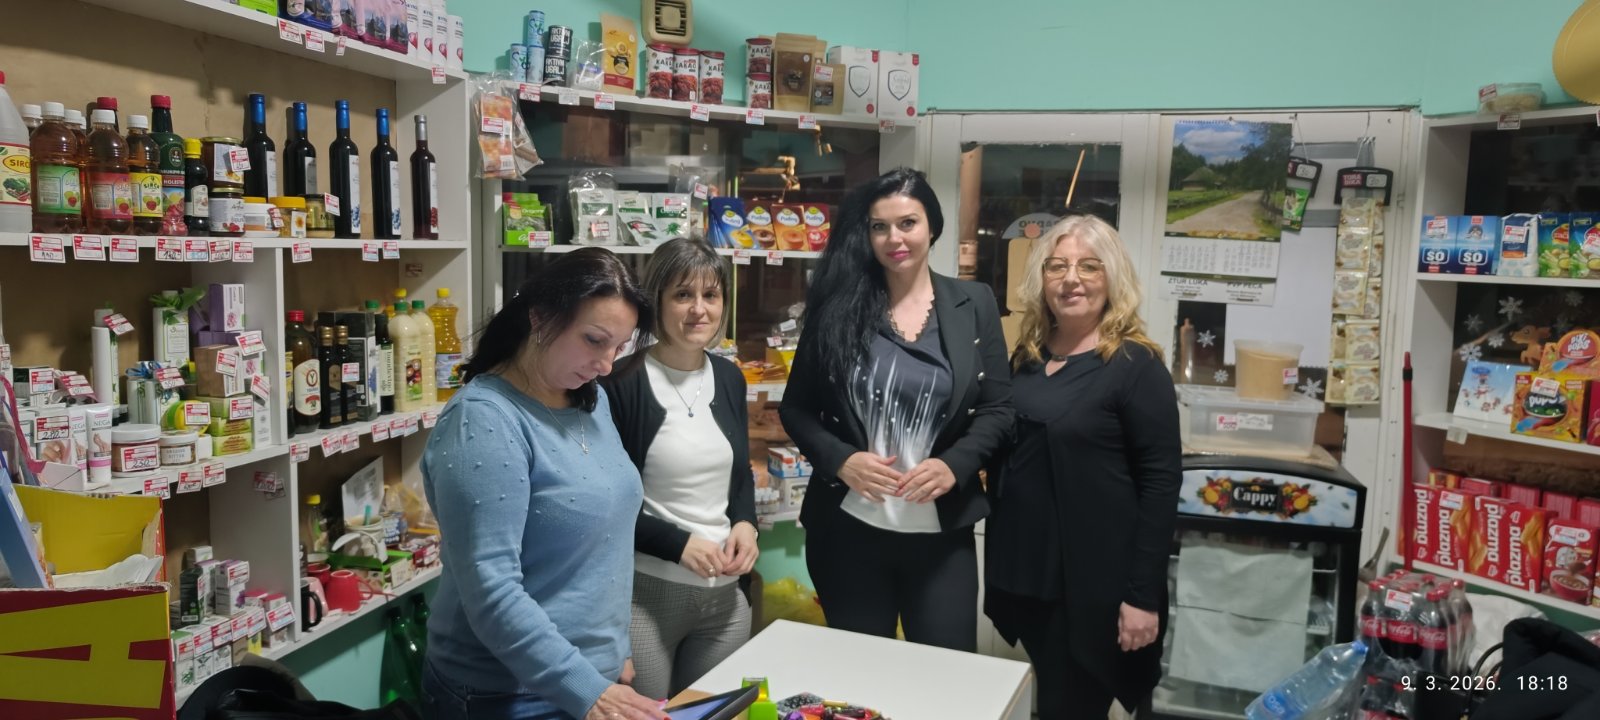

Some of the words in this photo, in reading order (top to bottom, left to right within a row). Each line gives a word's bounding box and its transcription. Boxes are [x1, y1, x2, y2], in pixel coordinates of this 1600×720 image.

[1233, 486, 1277, 507] Cappy
[1413, 489, 1431, 545] plazma
[1436, 509, 1454, 566] plazma
[1484, 504, 1502, 563] plazma
[1506, 526, 1525, 586] plazma
